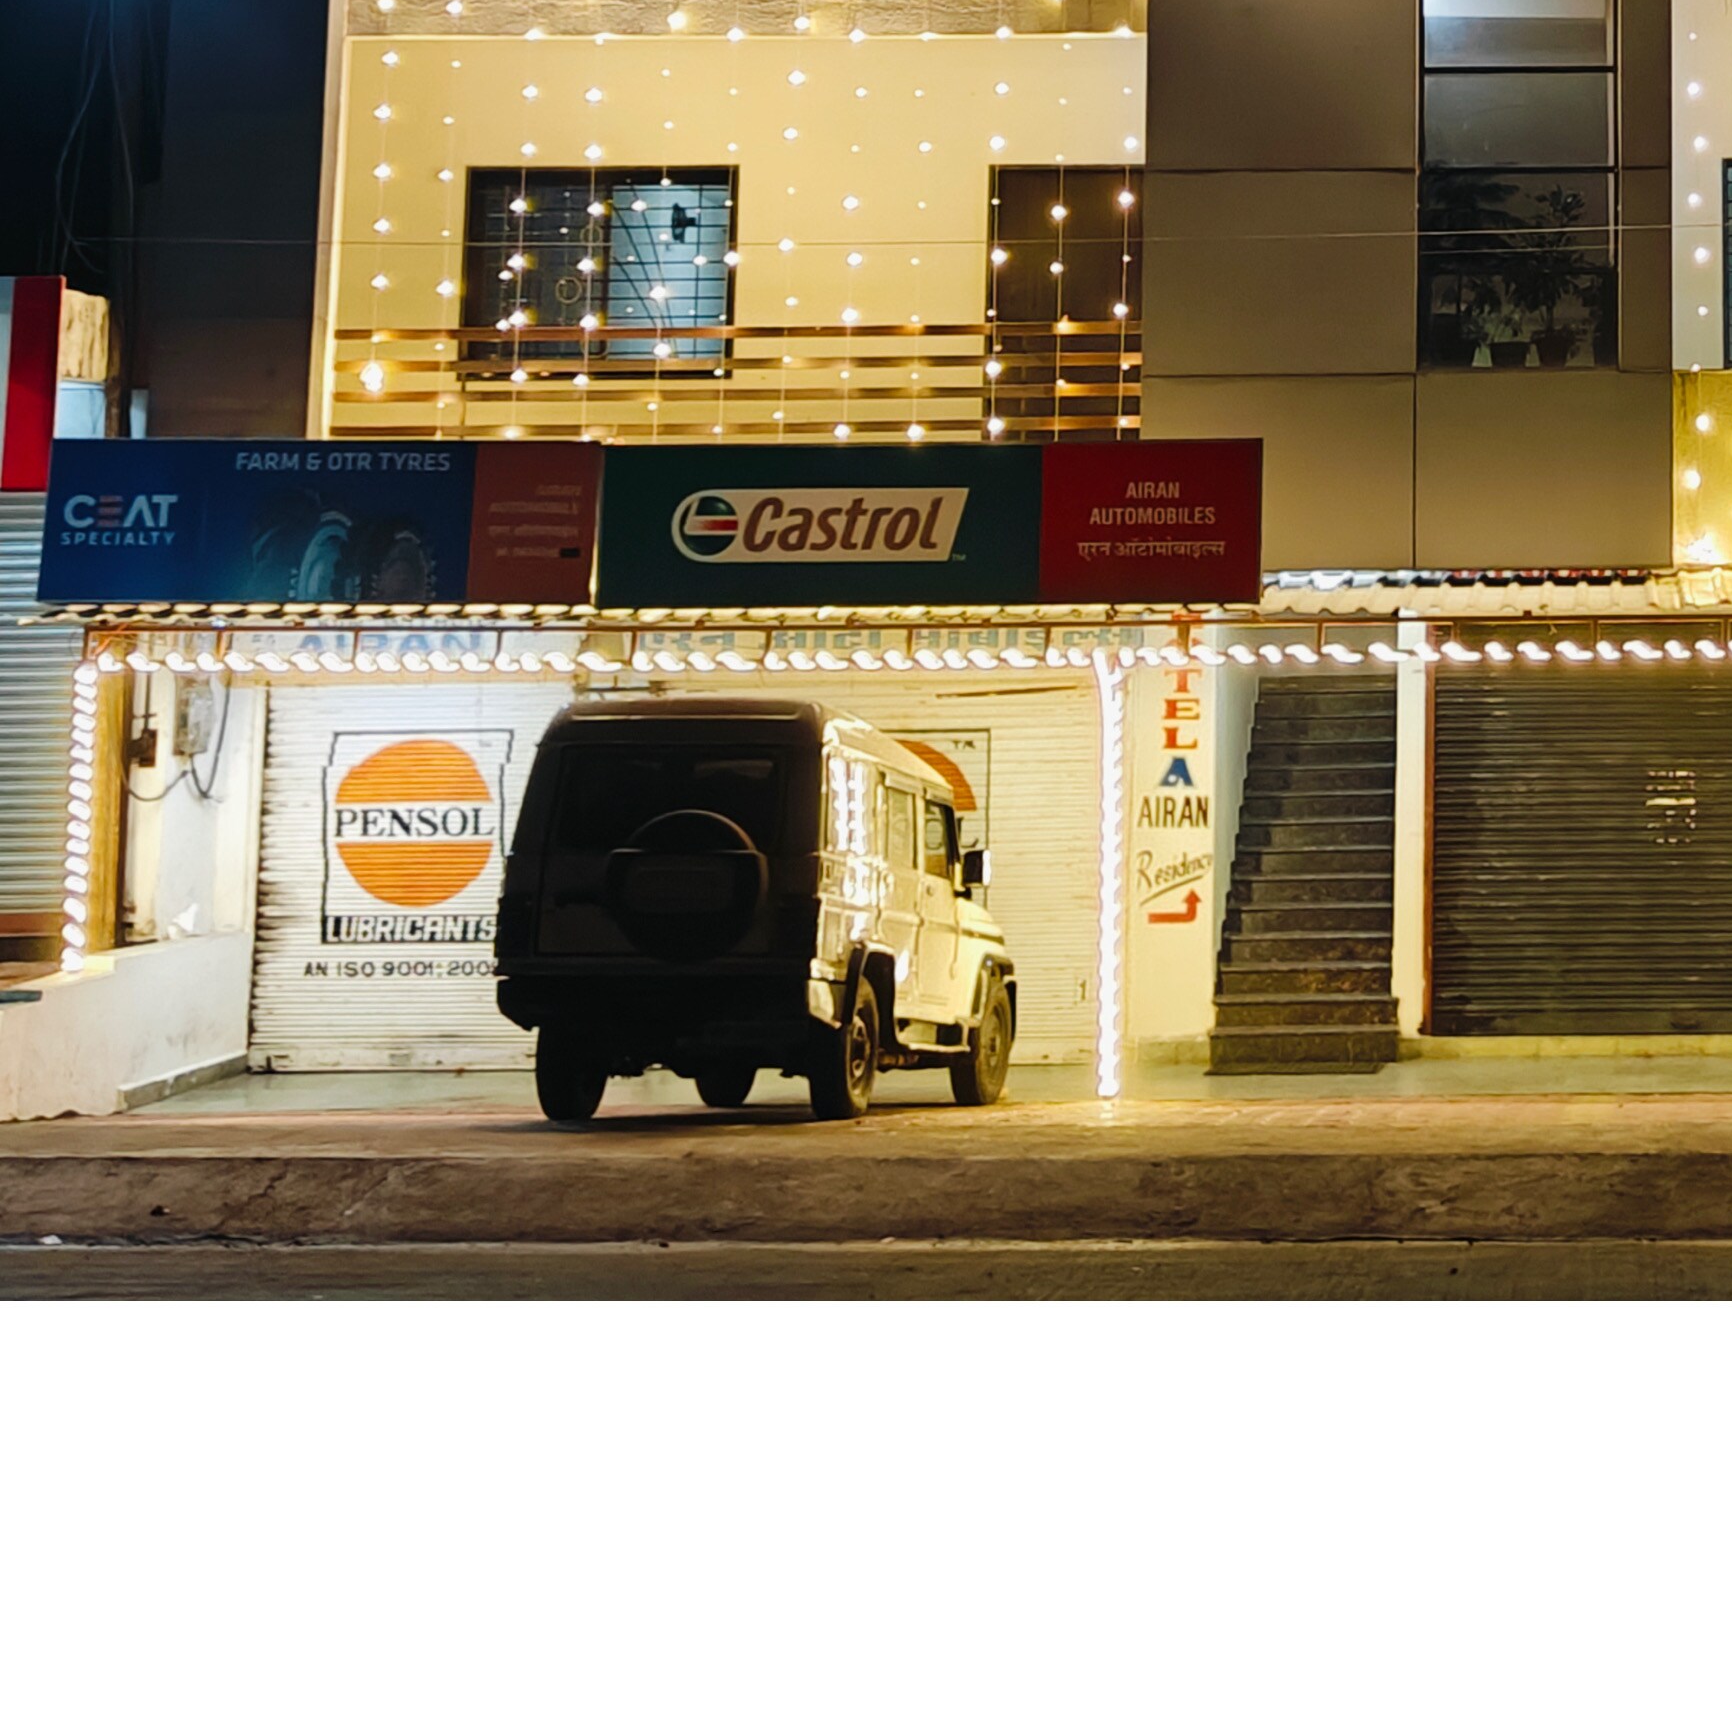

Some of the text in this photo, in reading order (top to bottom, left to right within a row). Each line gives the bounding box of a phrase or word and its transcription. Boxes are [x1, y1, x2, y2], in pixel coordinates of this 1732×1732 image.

[236, 452, 451, 471] FARM & OTR TYRES
[1125, 482, 1180, 499] AIRAN
[63, 494, 179, 528] CEAT
[1089, 507, 1216, 525] AUTOMOBILES
[743, 496, 944, 553] Castrol
[60, 531, 176, 546] SPECIALTY
[335, 807, 496, 837] PENSOL
[1137, 796, 1209, 827] AIRAN
[326, 915, 497, 942] LUBRICANTS
[303, 961, 497, 977] AN ISO 9001:200
